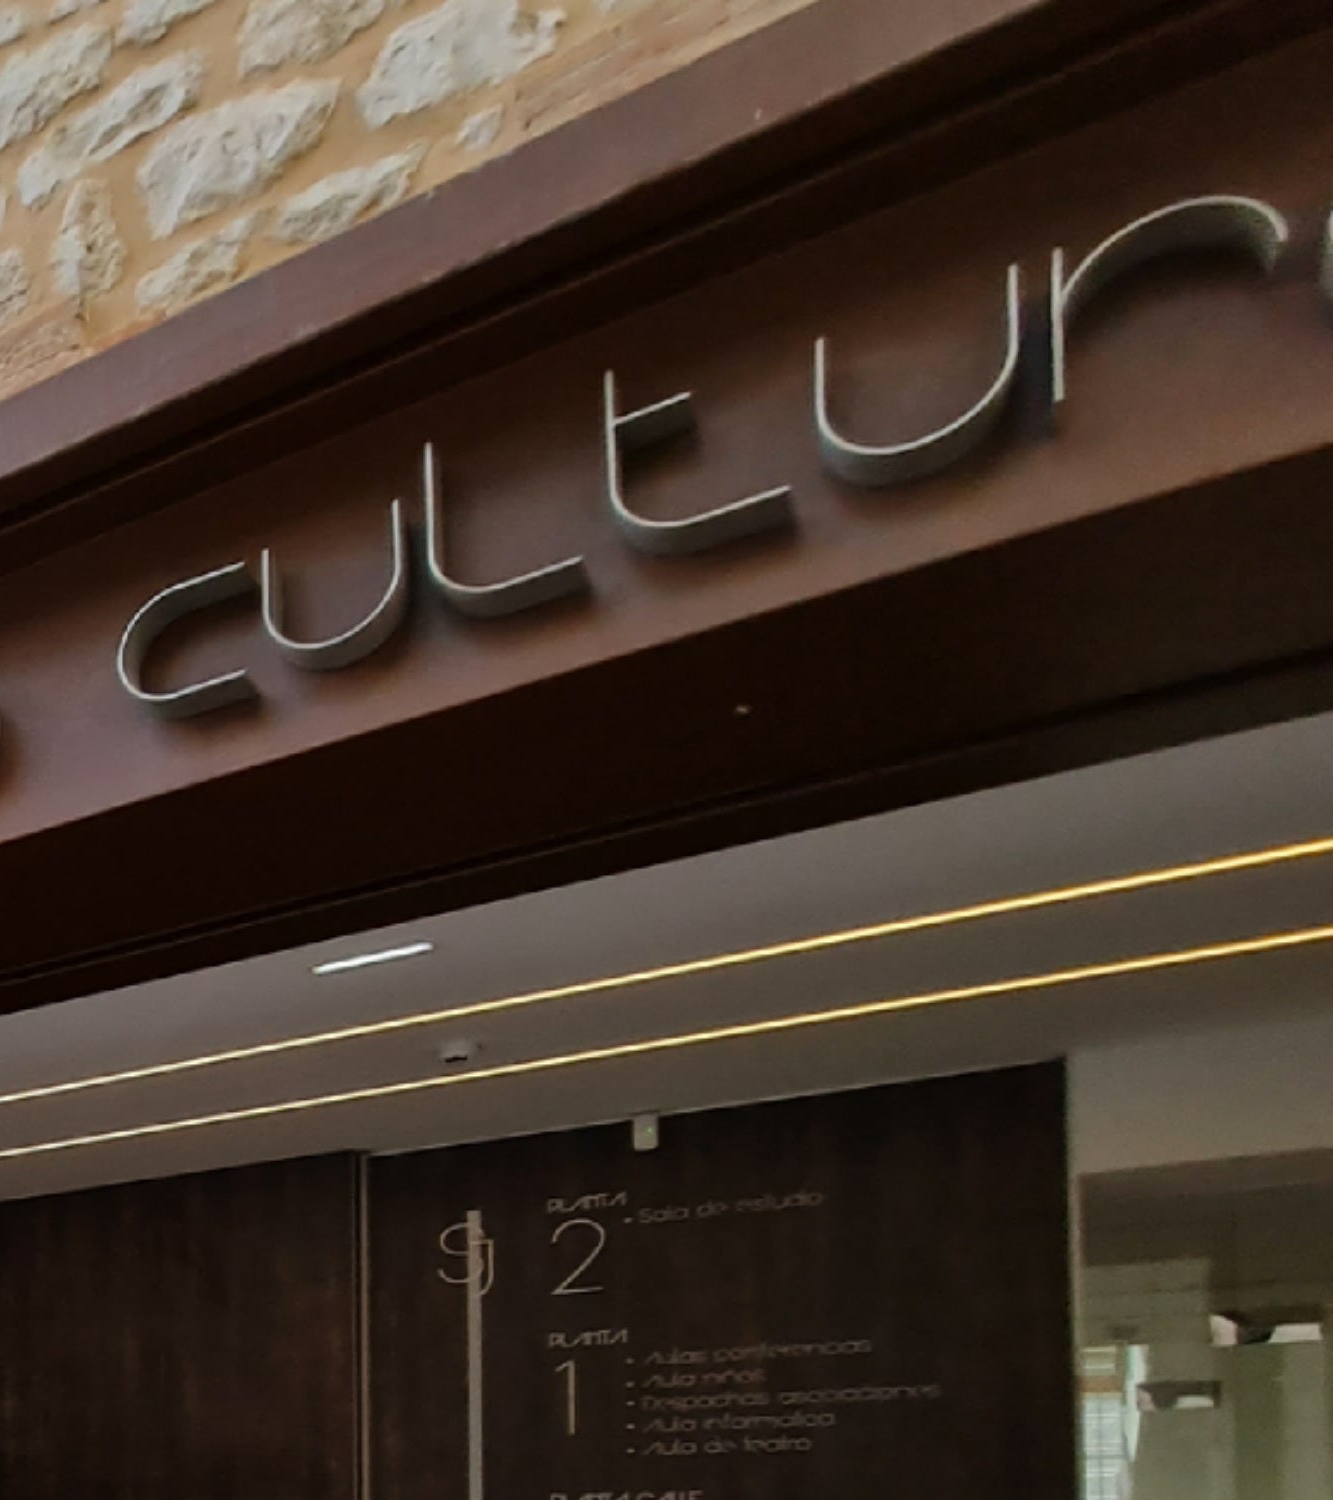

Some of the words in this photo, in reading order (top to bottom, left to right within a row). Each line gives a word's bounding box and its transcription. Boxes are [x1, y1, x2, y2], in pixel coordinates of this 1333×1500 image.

[114, 194, 1333, 720] cultur
[545, 1190, 627, 1214] PLANTA
[638, 1204, 689, 1224] Sala
[696, 1200, 726, 1218] de
[735, 1190, 824, 1213] estudio
[550, 1217, 607, 1296] 2
[547, 1327, 629, 1348] PLANTA
[643, 1346, 707, 1365] Aulas
[642, 1372, 696, 1389] Aula
[554, 1359, 577, 1436] 1
[642, 1415, 697, 1434] Aula
[642, 1438, 698, 1456] Aula
